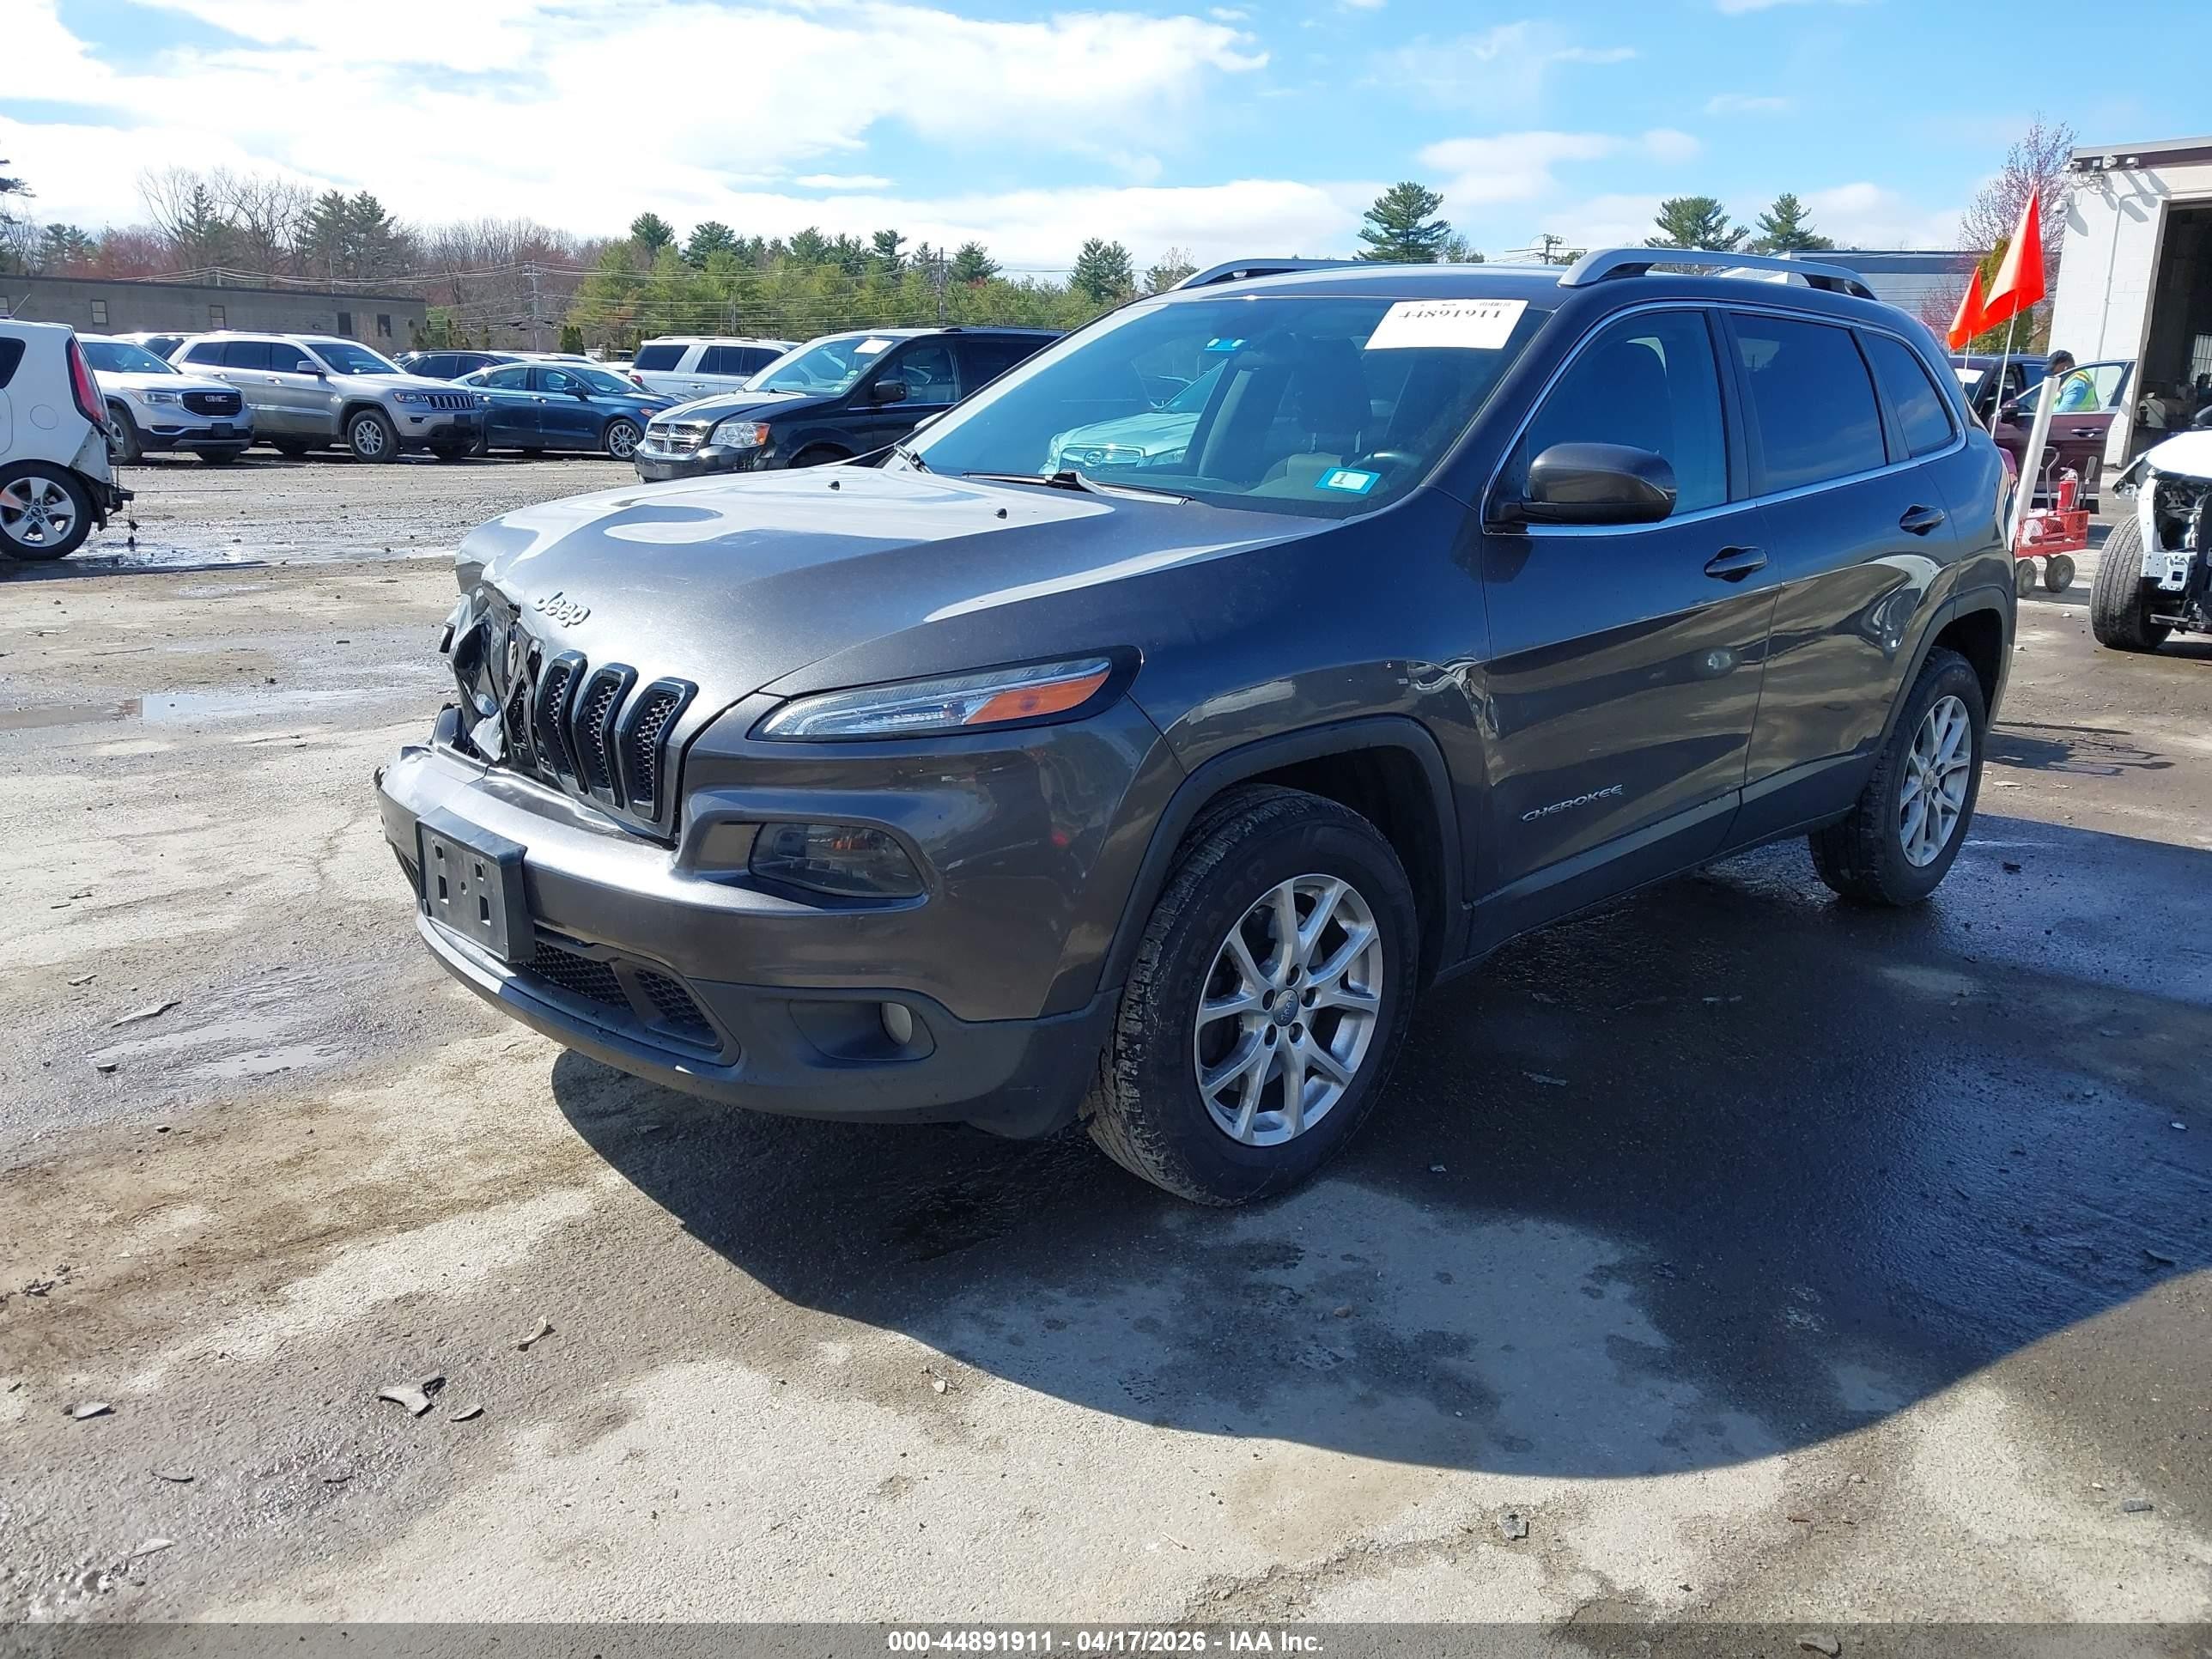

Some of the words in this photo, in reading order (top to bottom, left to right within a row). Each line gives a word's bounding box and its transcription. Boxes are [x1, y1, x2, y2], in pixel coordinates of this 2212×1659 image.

[1334, 472, 1349, 485] 1
[532, 591, 592, 629] Jeep
[1522, 783, 1624, 822] CHEROKEE
